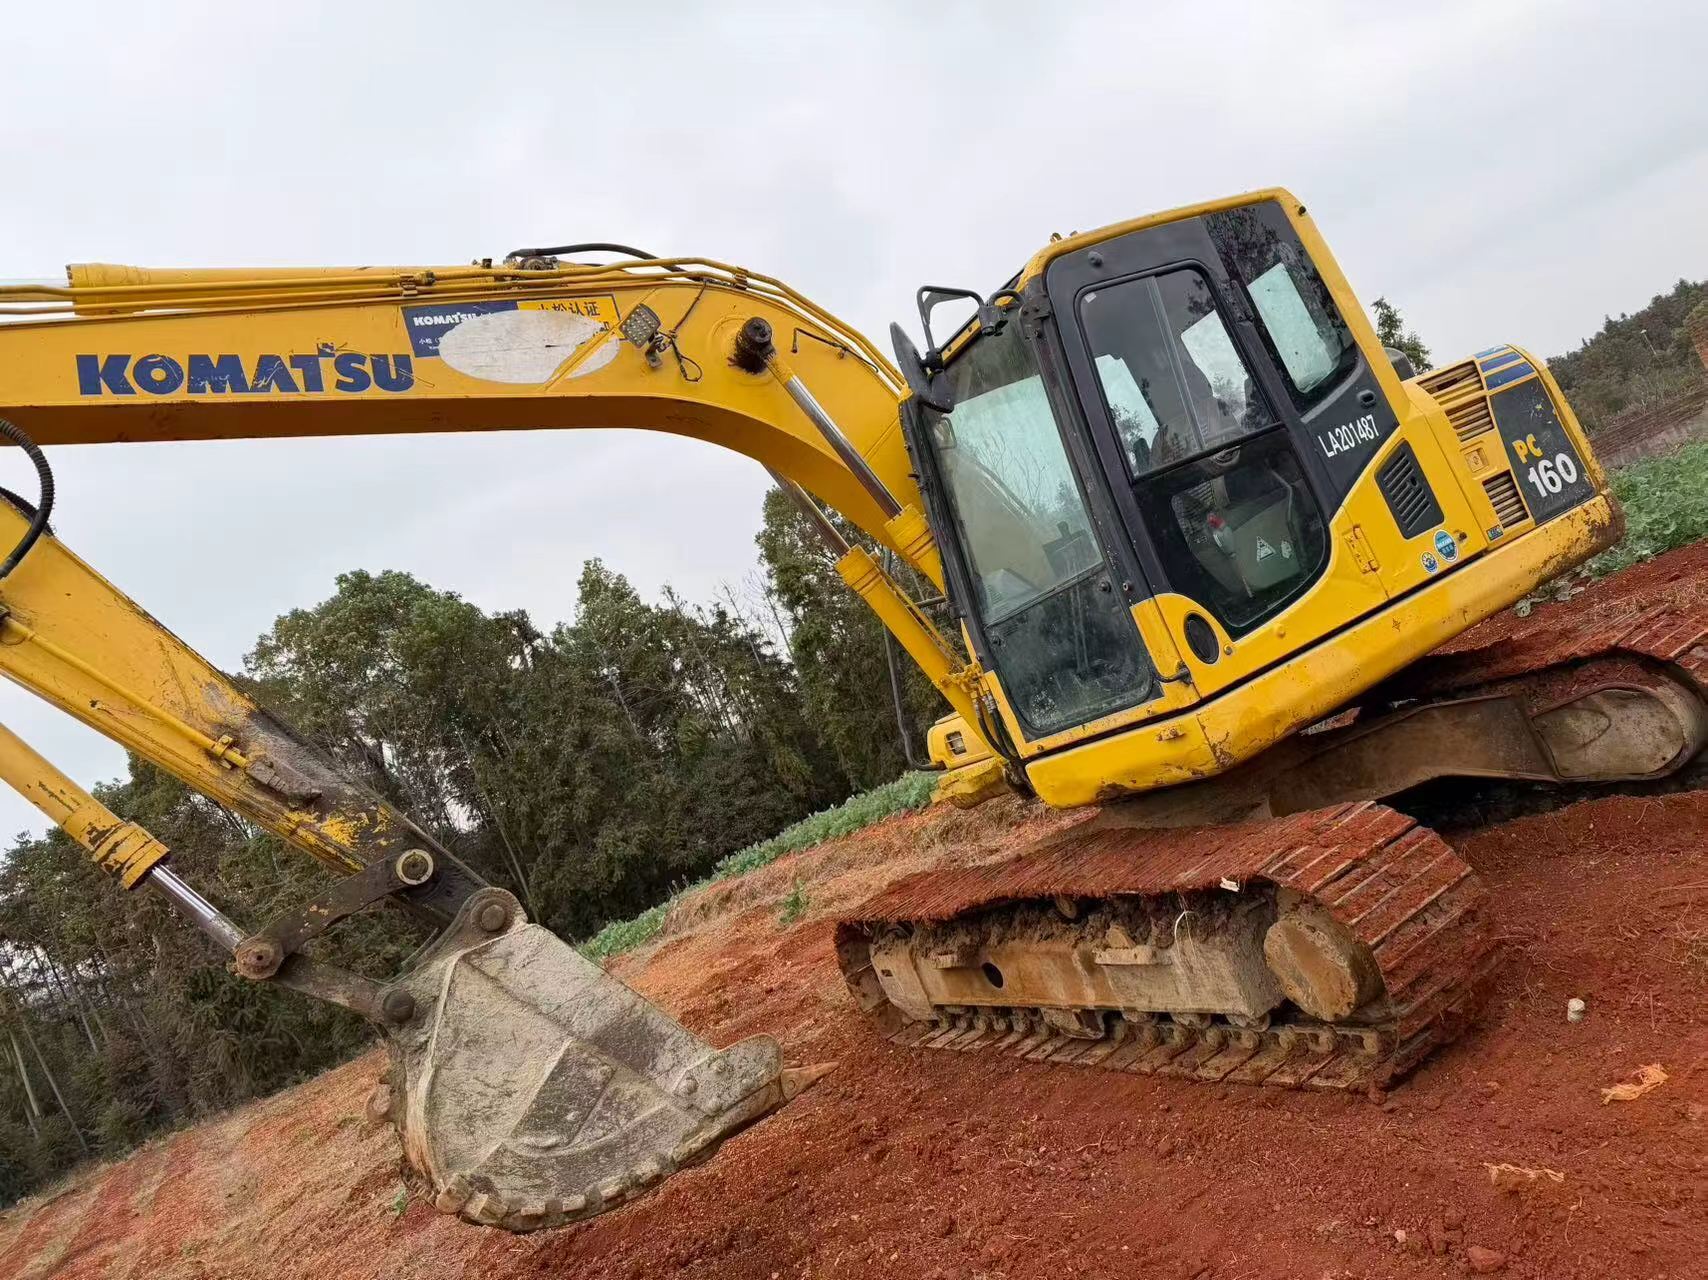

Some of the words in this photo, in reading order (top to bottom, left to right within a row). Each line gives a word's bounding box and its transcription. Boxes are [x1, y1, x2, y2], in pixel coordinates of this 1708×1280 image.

[76, 352, 415, 395] KOMATSU
[1318, 414, 1379, 457] LA201487
[1512, 433, 1543, 464] PC
[1528, 453, 1578, 497] 160
